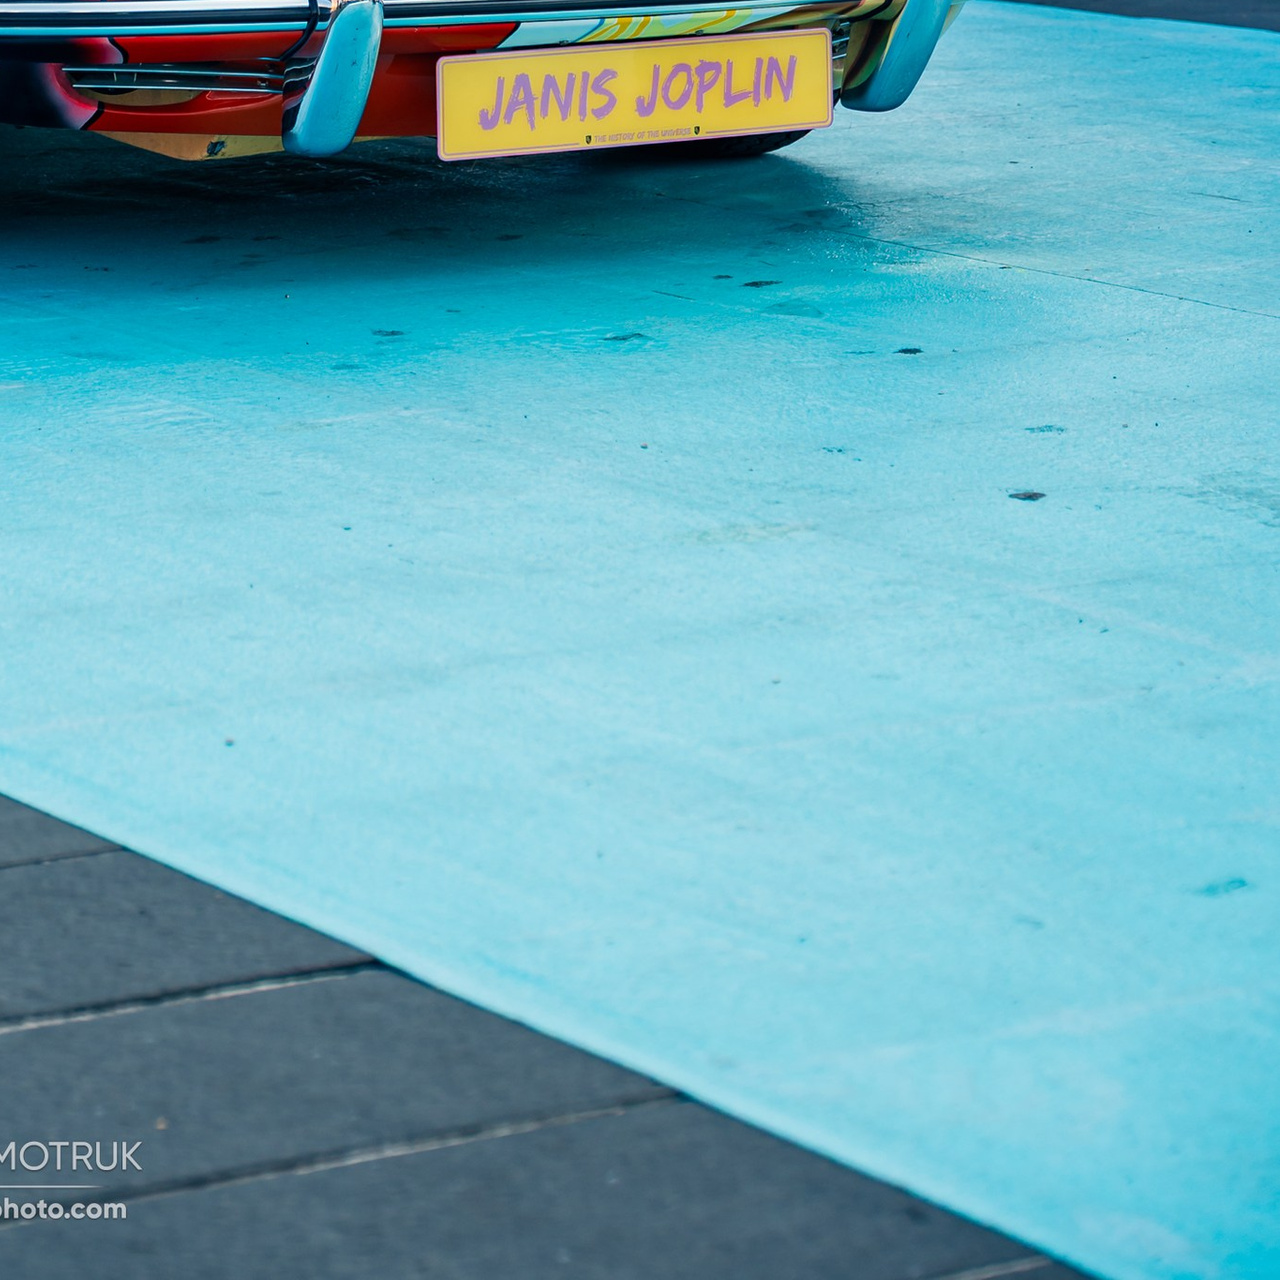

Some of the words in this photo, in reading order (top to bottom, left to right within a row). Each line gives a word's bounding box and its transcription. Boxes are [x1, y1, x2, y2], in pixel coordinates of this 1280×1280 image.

[478, 68, 618, 131] JANIS
[635, 55, 797, 117] JOPLIN
[594, 135, 607, 144] THE
[608, 132, 635, 142] HISTORY
[637, 131, 646, 140] OF
[647, 130, 660, 139] THE
[661, 127, 692, 138] UNIVERSE
